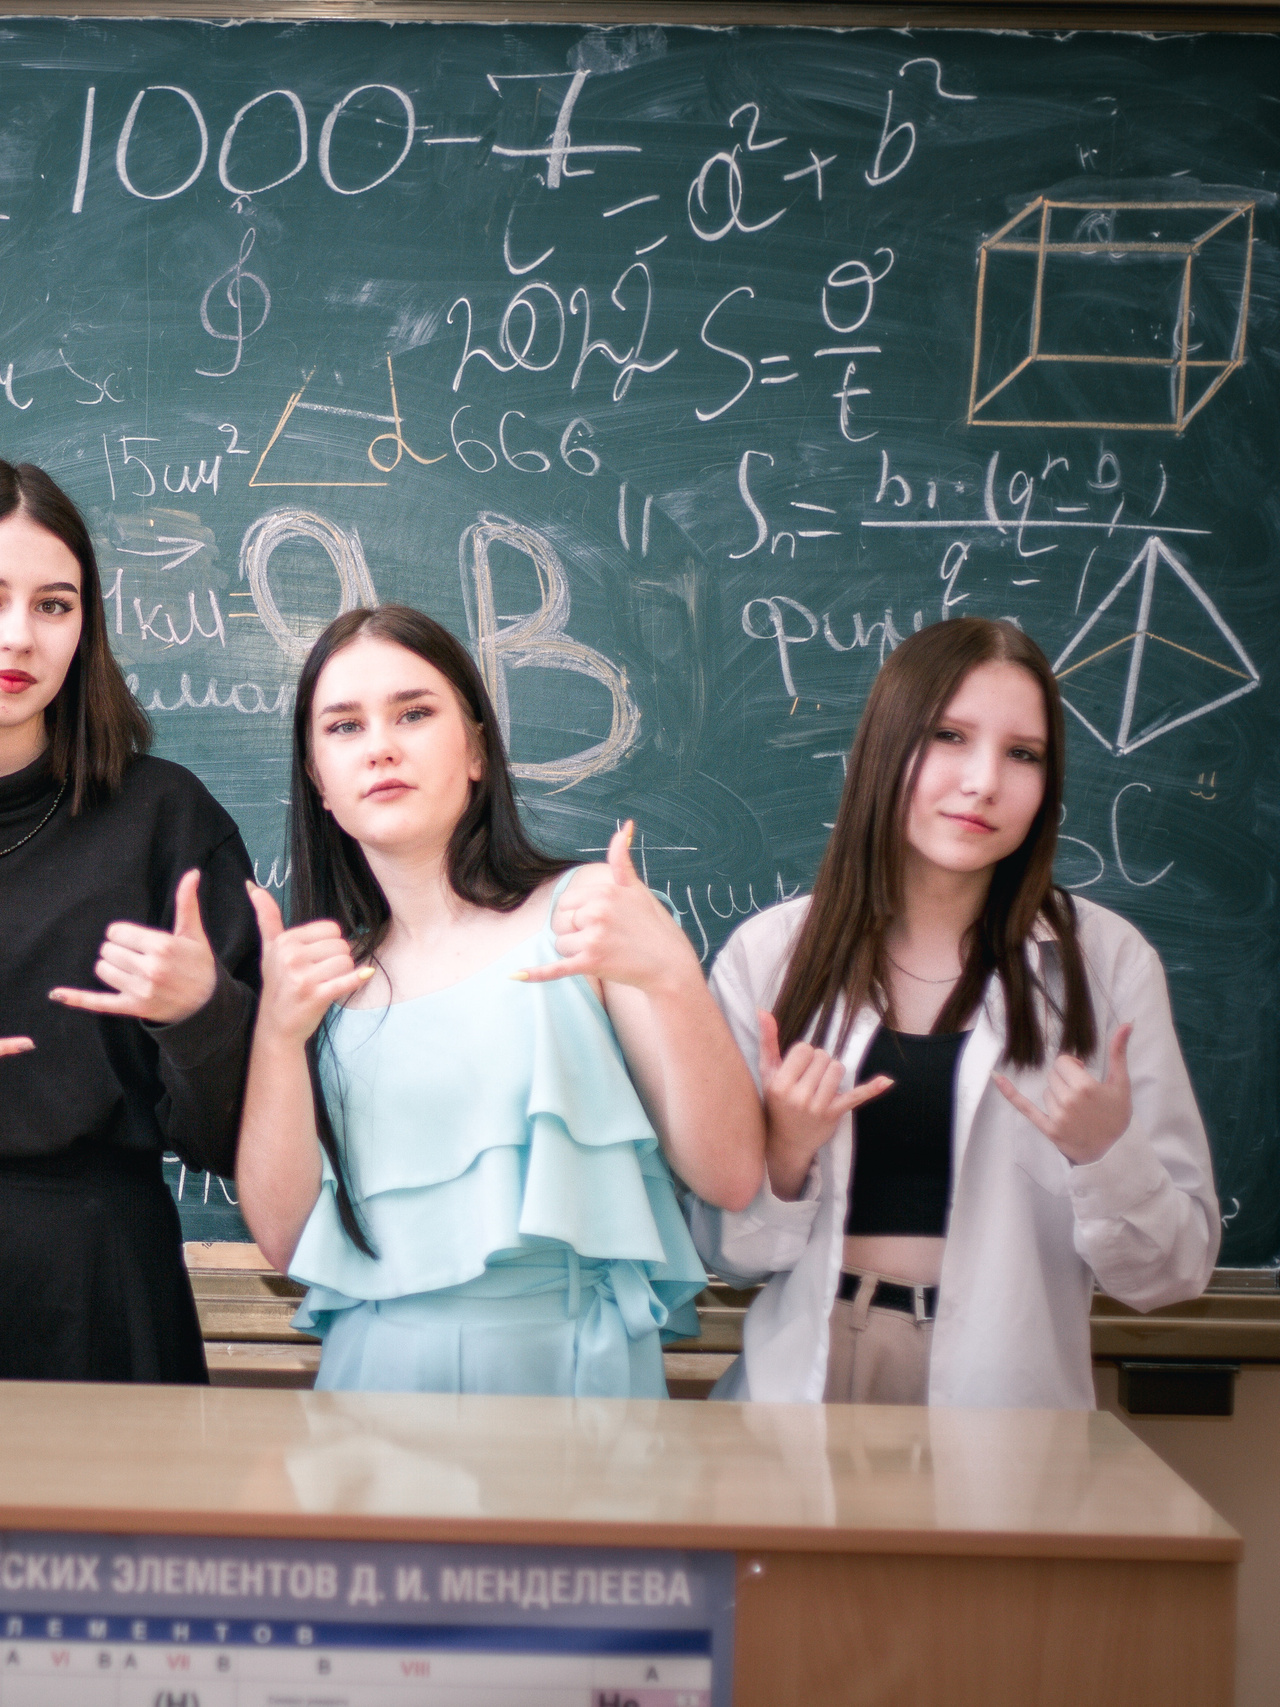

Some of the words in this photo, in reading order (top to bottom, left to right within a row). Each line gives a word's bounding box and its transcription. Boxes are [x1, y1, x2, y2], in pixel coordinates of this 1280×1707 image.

[451, 404, 600, 477] 666
[112, 1555, 338, 1600] ЭЛЕМЕНТОВ
[348, 1563, 386, 1607] Д.
[395, 1567, 430, 1602] И.
[440, 1567, 691, 1610] МЕНДЕЛЕЕВА
